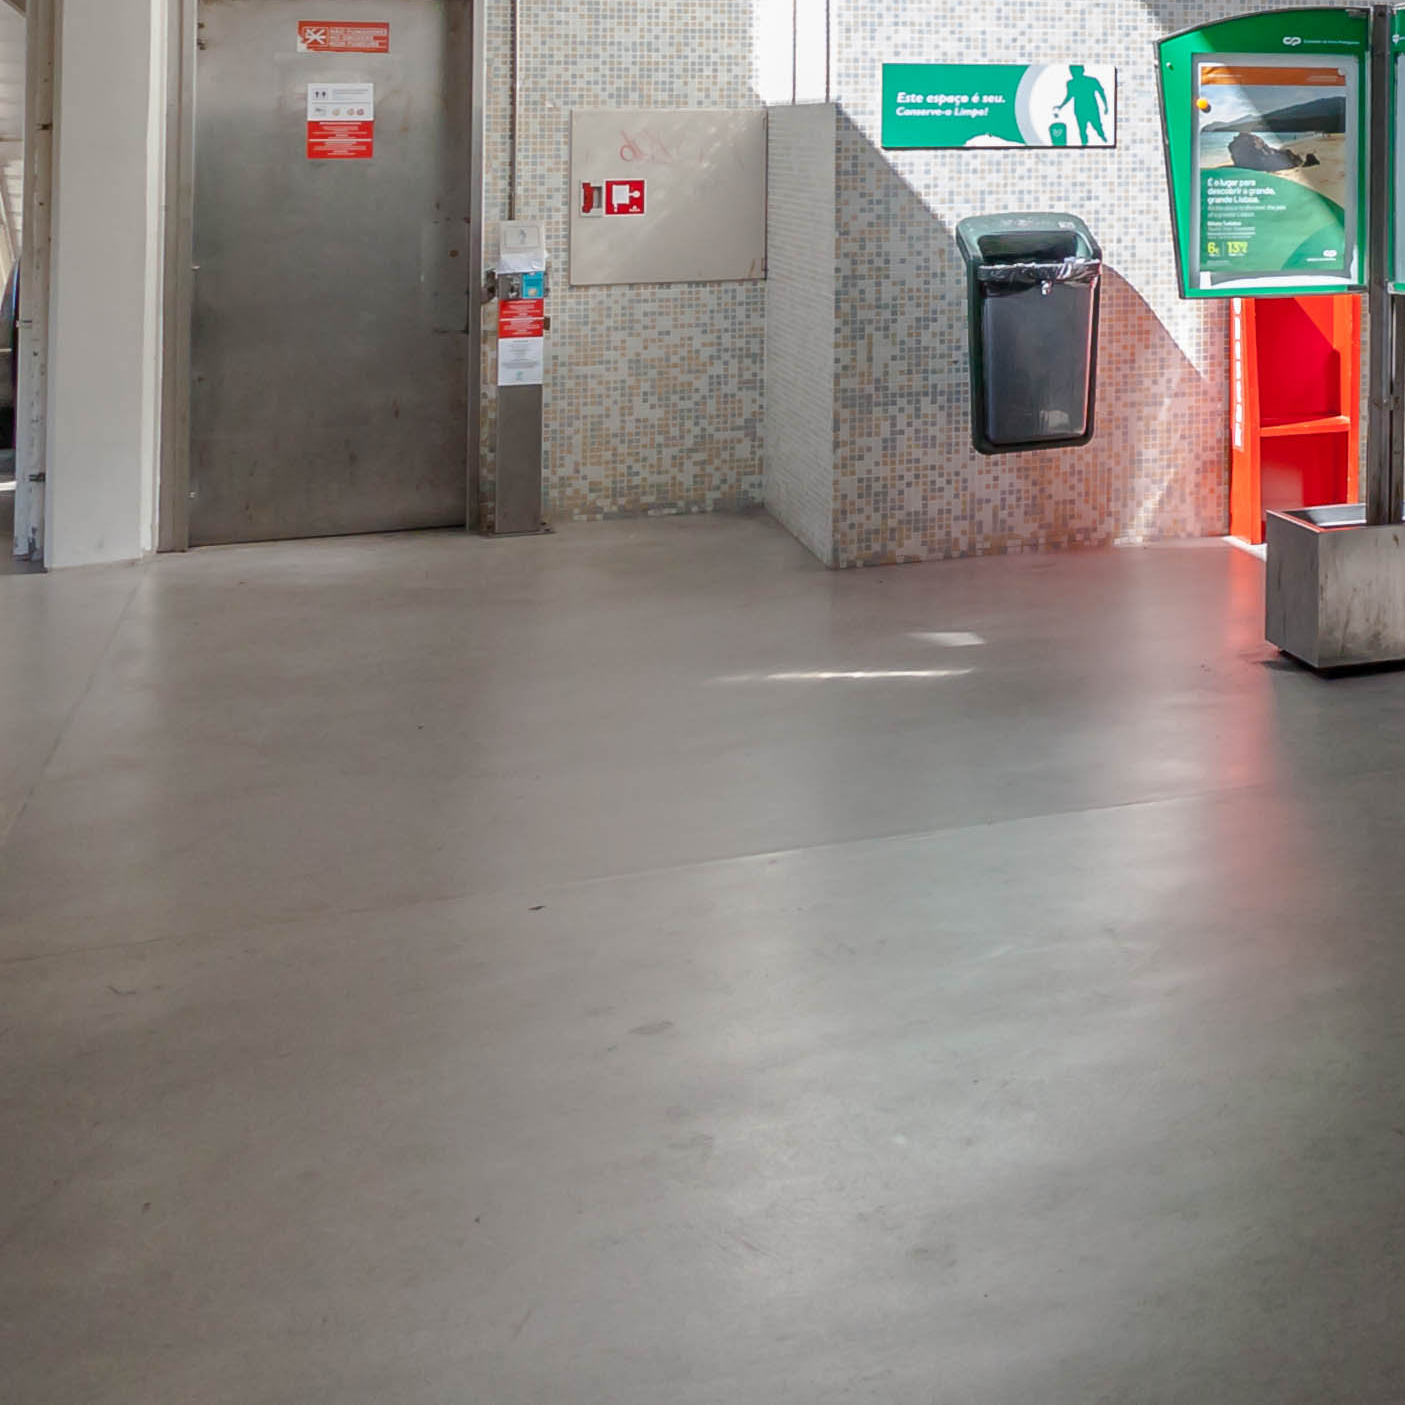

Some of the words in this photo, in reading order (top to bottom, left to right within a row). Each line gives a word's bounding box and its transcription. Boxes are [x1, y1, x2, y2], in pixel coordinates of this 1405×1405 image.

[896, 92, 924, 103] Este
[926, 93, 969, 106] espaço
[971, 92, 980, 103] é
[981, 94, 1006, 103] seu.
[895, 106, 952, 116] Conserve-o
[953, 106, 989, 119] Limpo!
